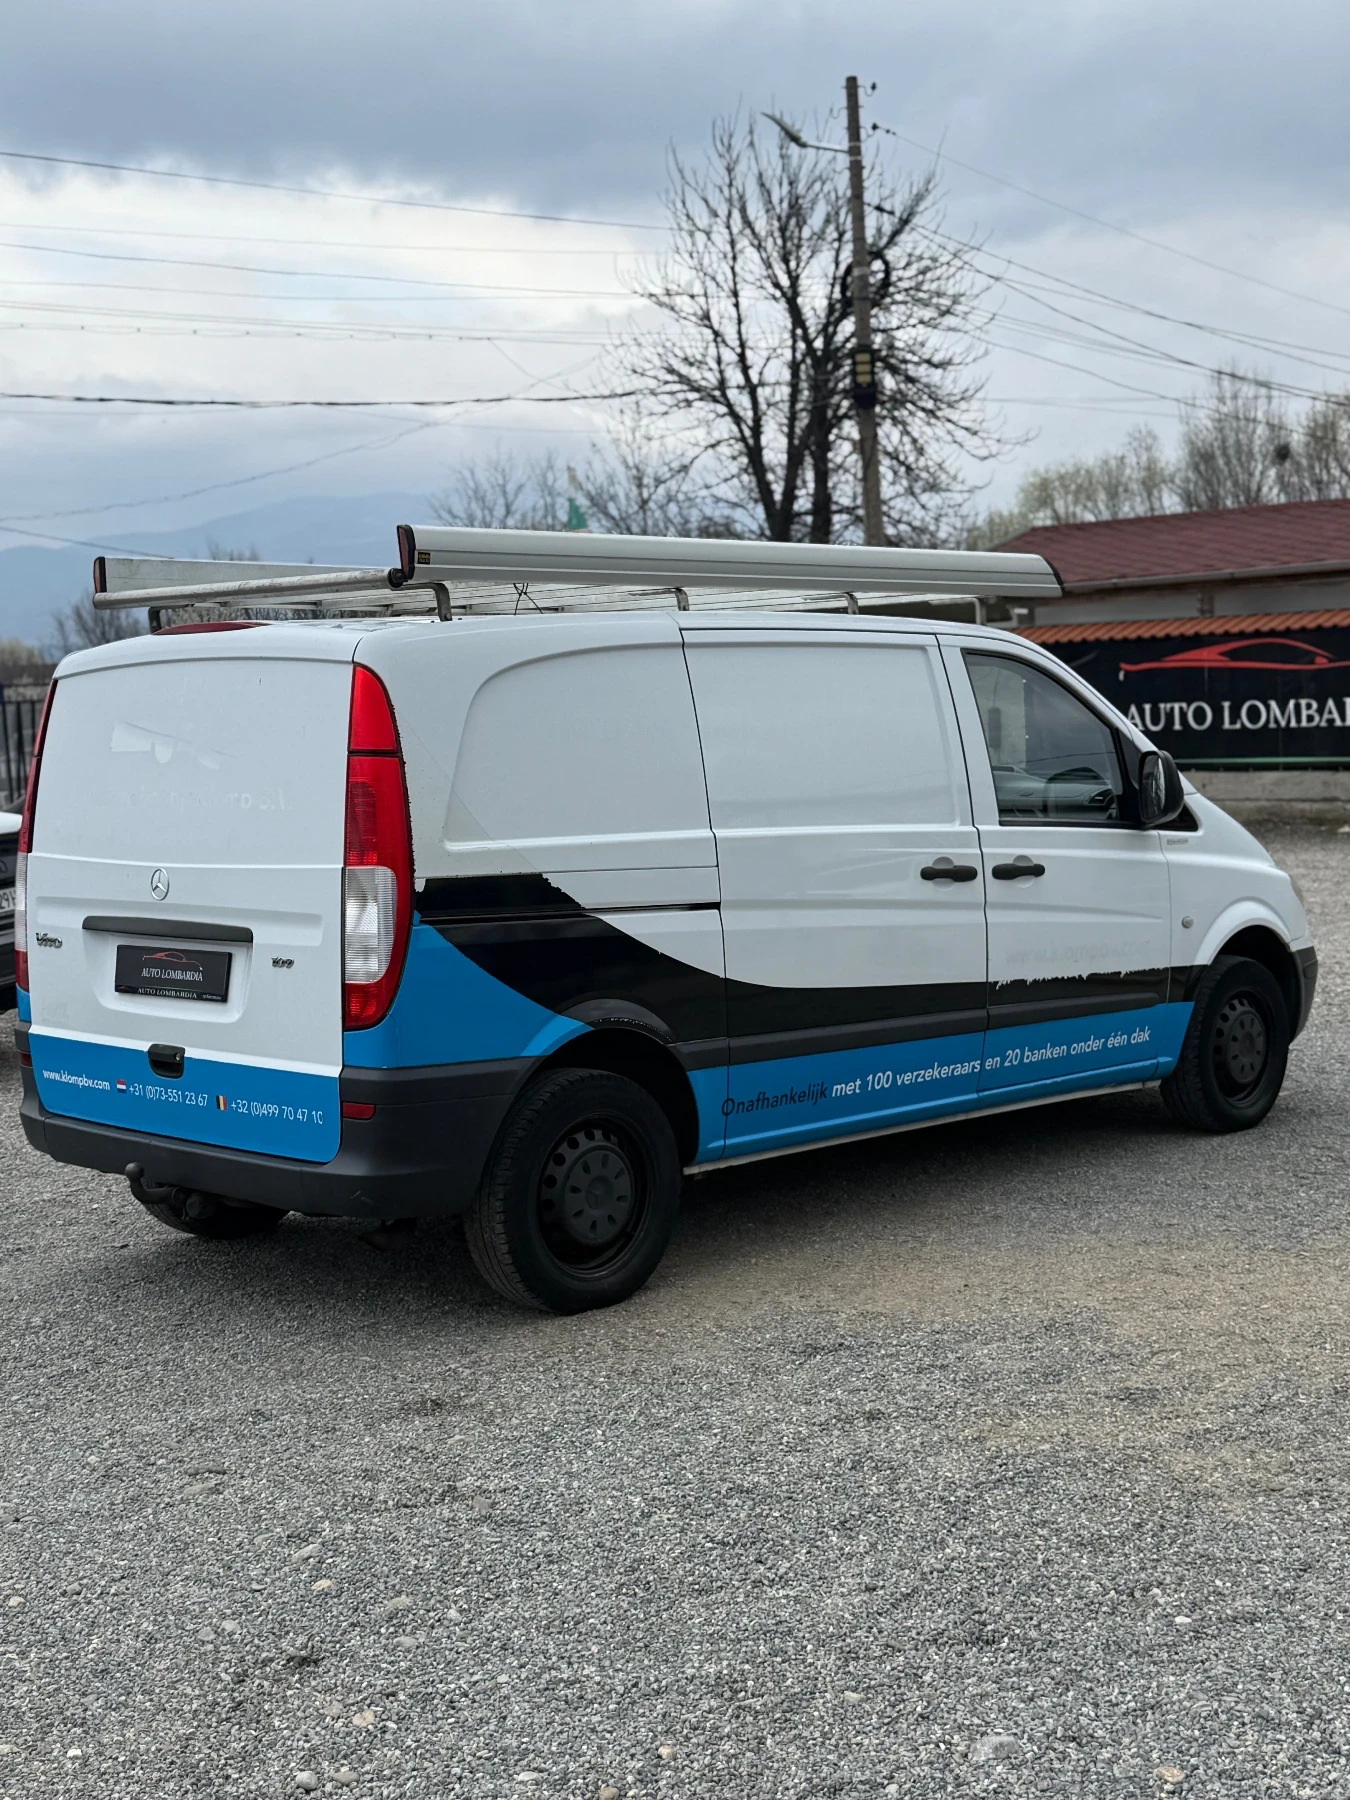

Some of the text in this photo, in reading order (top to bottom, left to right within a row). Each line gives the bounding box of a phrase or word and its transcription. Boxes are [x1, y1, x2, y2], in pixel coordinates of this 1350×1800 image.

[1127, 701, 1213, 732] AUTO
[141, 967, 203, 982] AUTO LOMBARDIA
[137, 987, 156, 995] AUTO
[157, 989, 197, 999] LOMBARDIA
[43, 1070, 111, 1090] www.klompbv.com
[721, 1026, 1151, 1116] Onafhankelijk met 100 verzekeraars en 20 banken onder één dak
[129, 1083, 208, 1107] +31 (0)73-551 23 67
[231, 1099, 249, 1114] +32
[250, 1101, 279, 1118] (0)499
[281, 1105, 294, 1121] 70
[296, 1108, 308, 1122] 47
